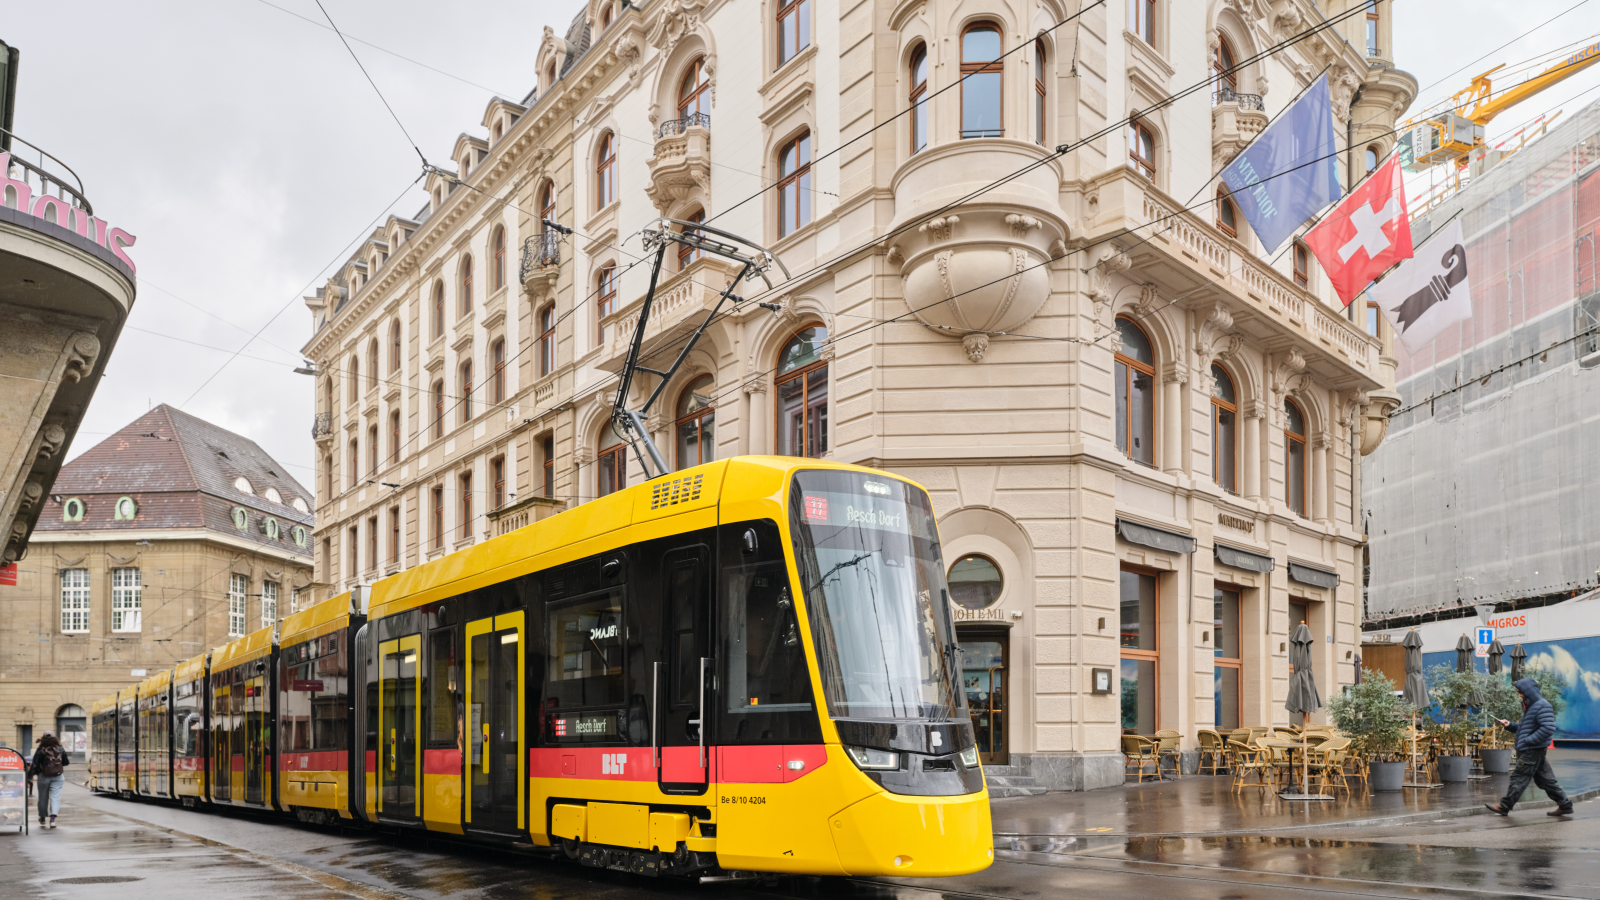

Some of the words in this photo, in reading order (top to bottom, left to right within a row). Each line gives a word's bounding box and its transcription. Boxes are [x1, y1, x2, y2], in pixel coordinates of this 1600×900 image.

[811, 498, 823, 518] 11
[847, 505, 877, 525] Aesch
[878, 509, 901, 528] Dorf
[953, 609, 1004, 620] BOHEMI
[1486, 615, 1526, 629] MIGROS
[575, 719, 592, 733] Aesch
[593, 718, 606, 733] Dorf
[602, 753, 627, 775] BLT
[721, 795, 730, 804] Be
[731, 796, 748, 805] 8/10
[748, 796, 766, 805] 4204
